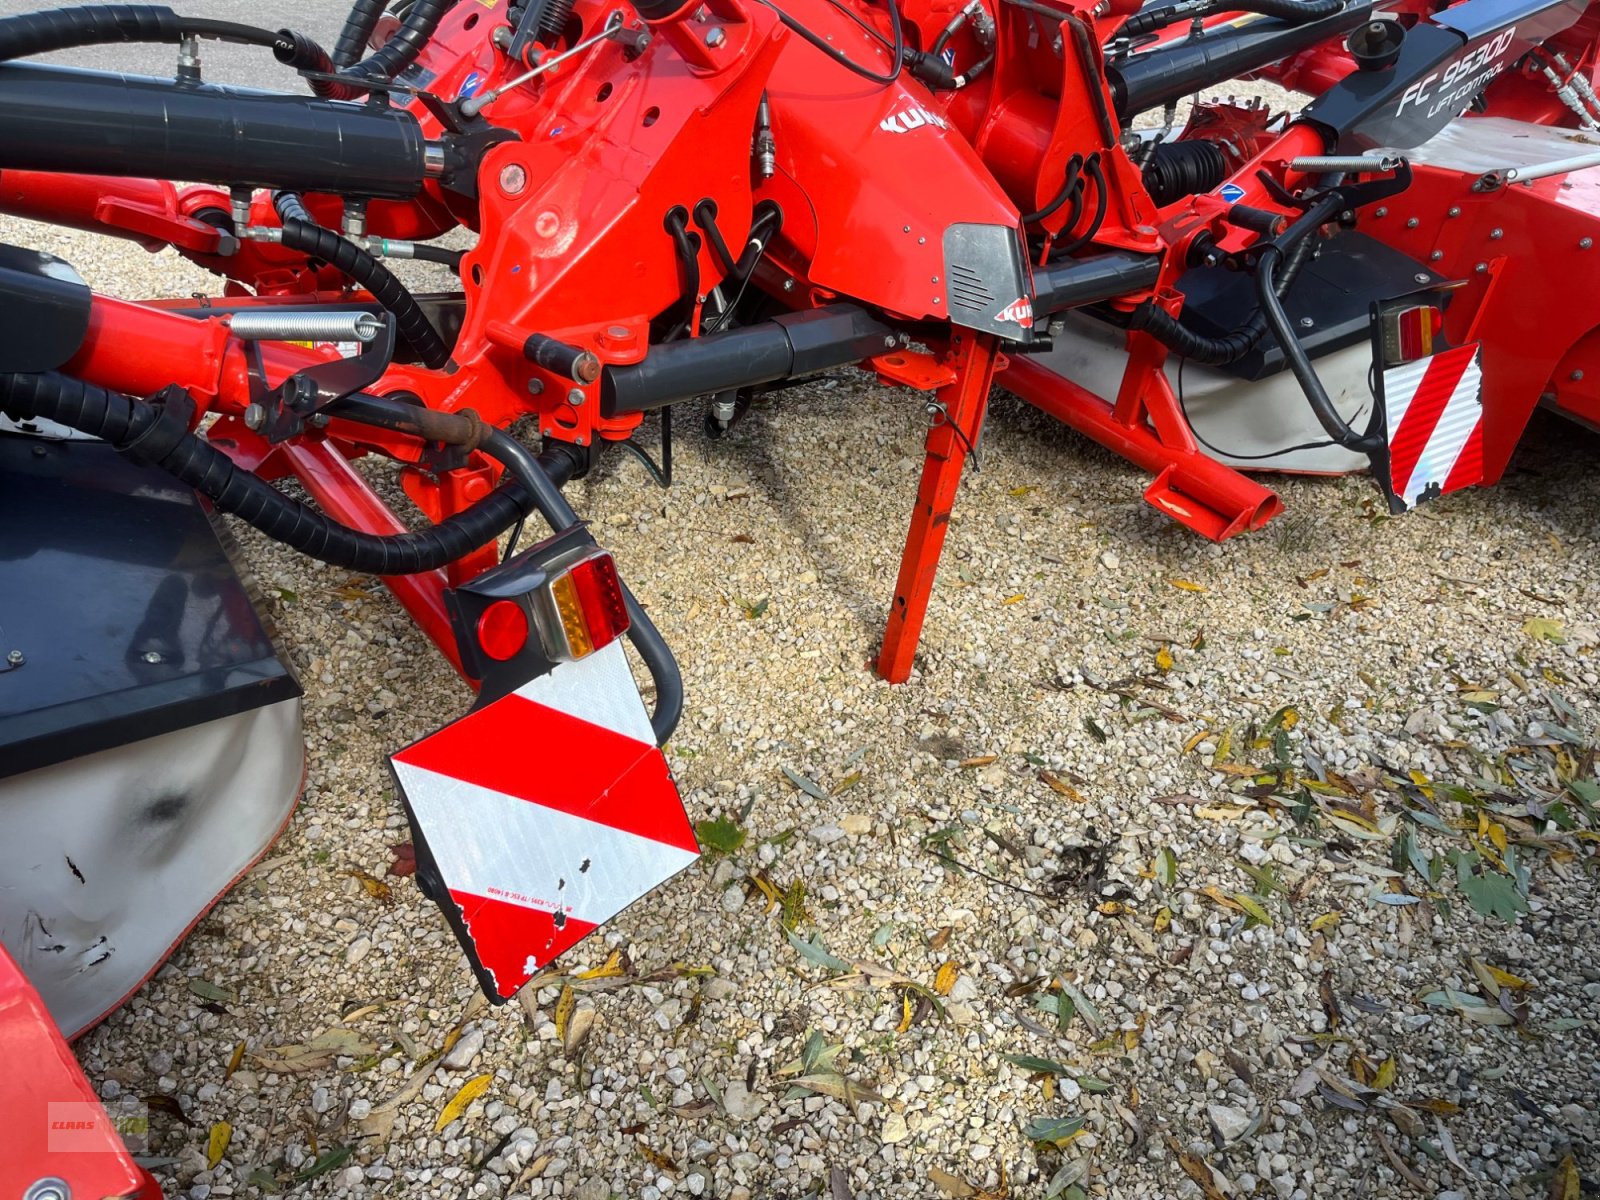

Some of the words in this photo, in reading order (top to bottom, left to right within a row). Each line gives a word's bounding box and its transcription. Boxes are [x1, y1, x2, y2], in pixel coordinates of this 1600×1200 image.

[1396, 73, 1438, 118] FC
[1427, 91, 1456, 118] LIFT
[1455, 61, 1504, 100] CONTROL
